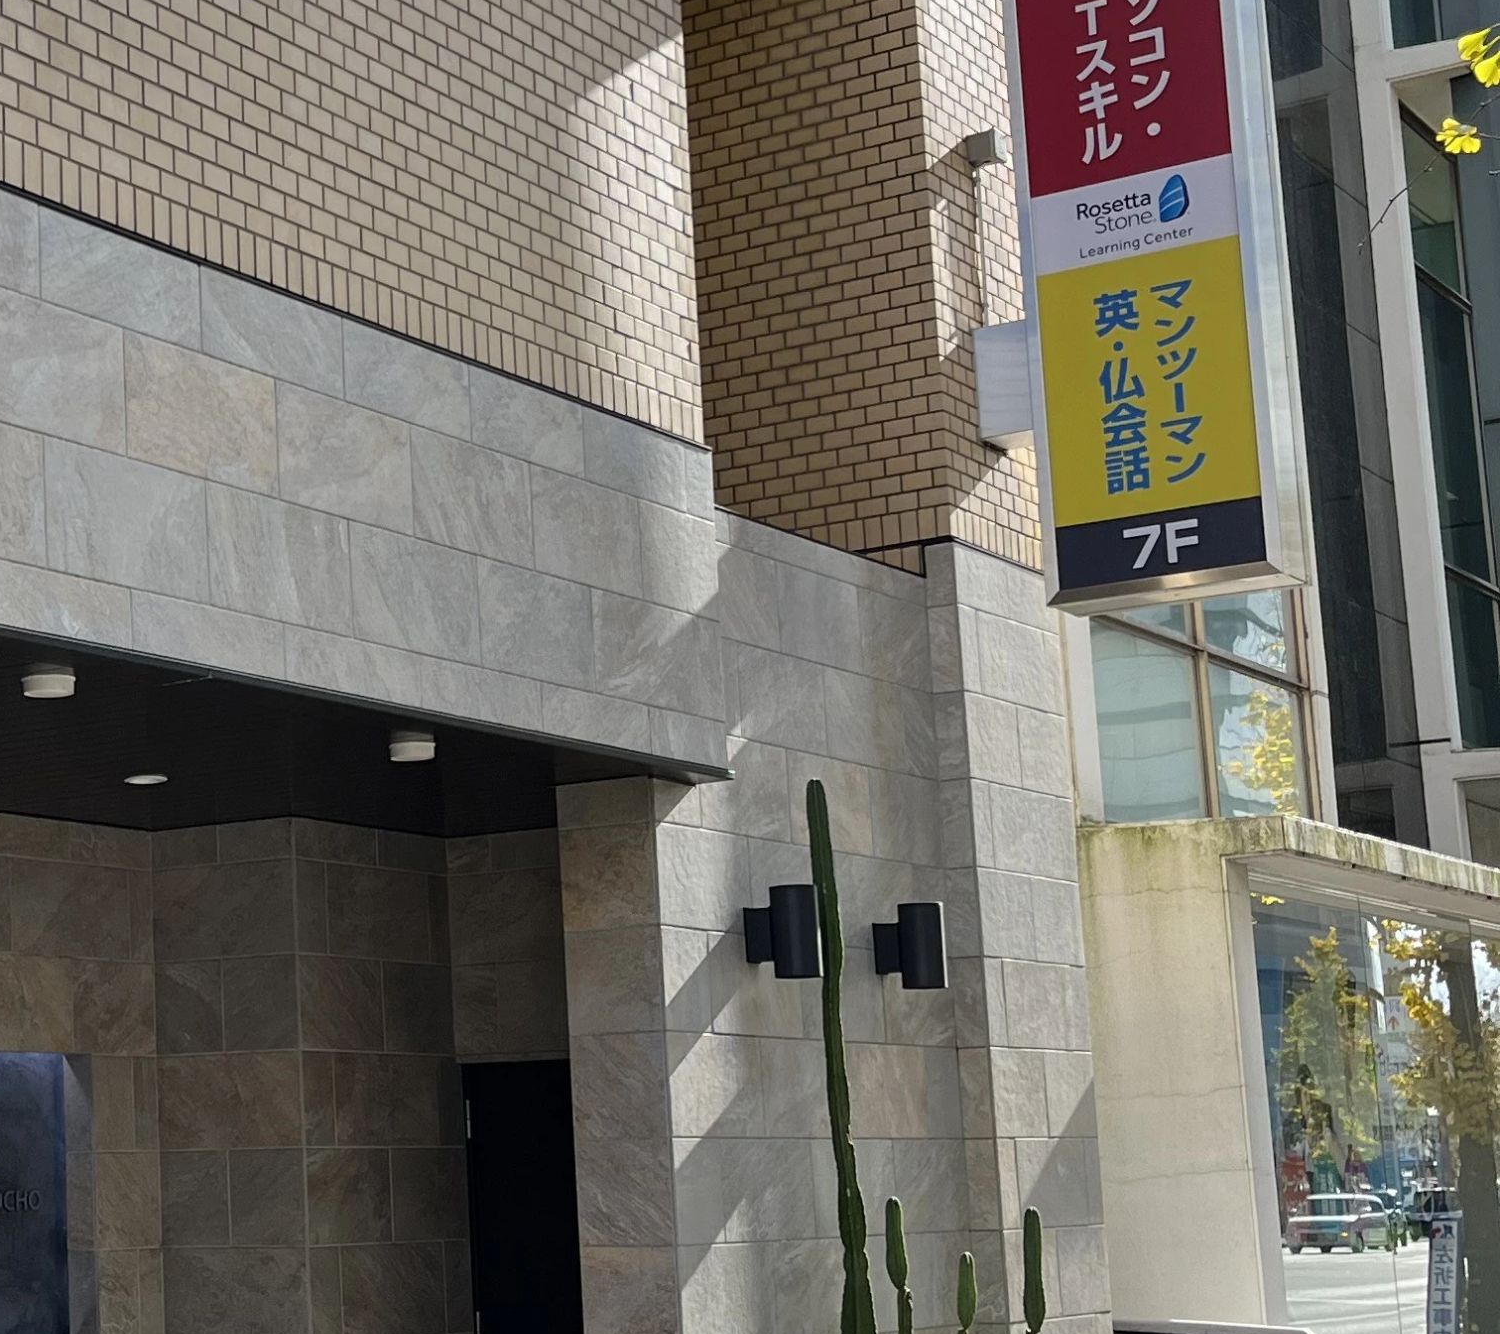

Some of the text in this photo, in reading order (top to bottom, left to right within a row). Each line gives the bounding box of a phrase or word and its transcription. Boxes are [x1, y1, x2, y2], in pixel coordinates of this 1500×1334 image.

[1076, 192, 1152, 221] Rosetta
[1080, 227, 1194, 259] Learning Center
[1093, 289, 1150, 495] 英・仏会話
[1150, 279, 1206, 484] マンツーマン
[1122, 517, 1200, 570] 7F
